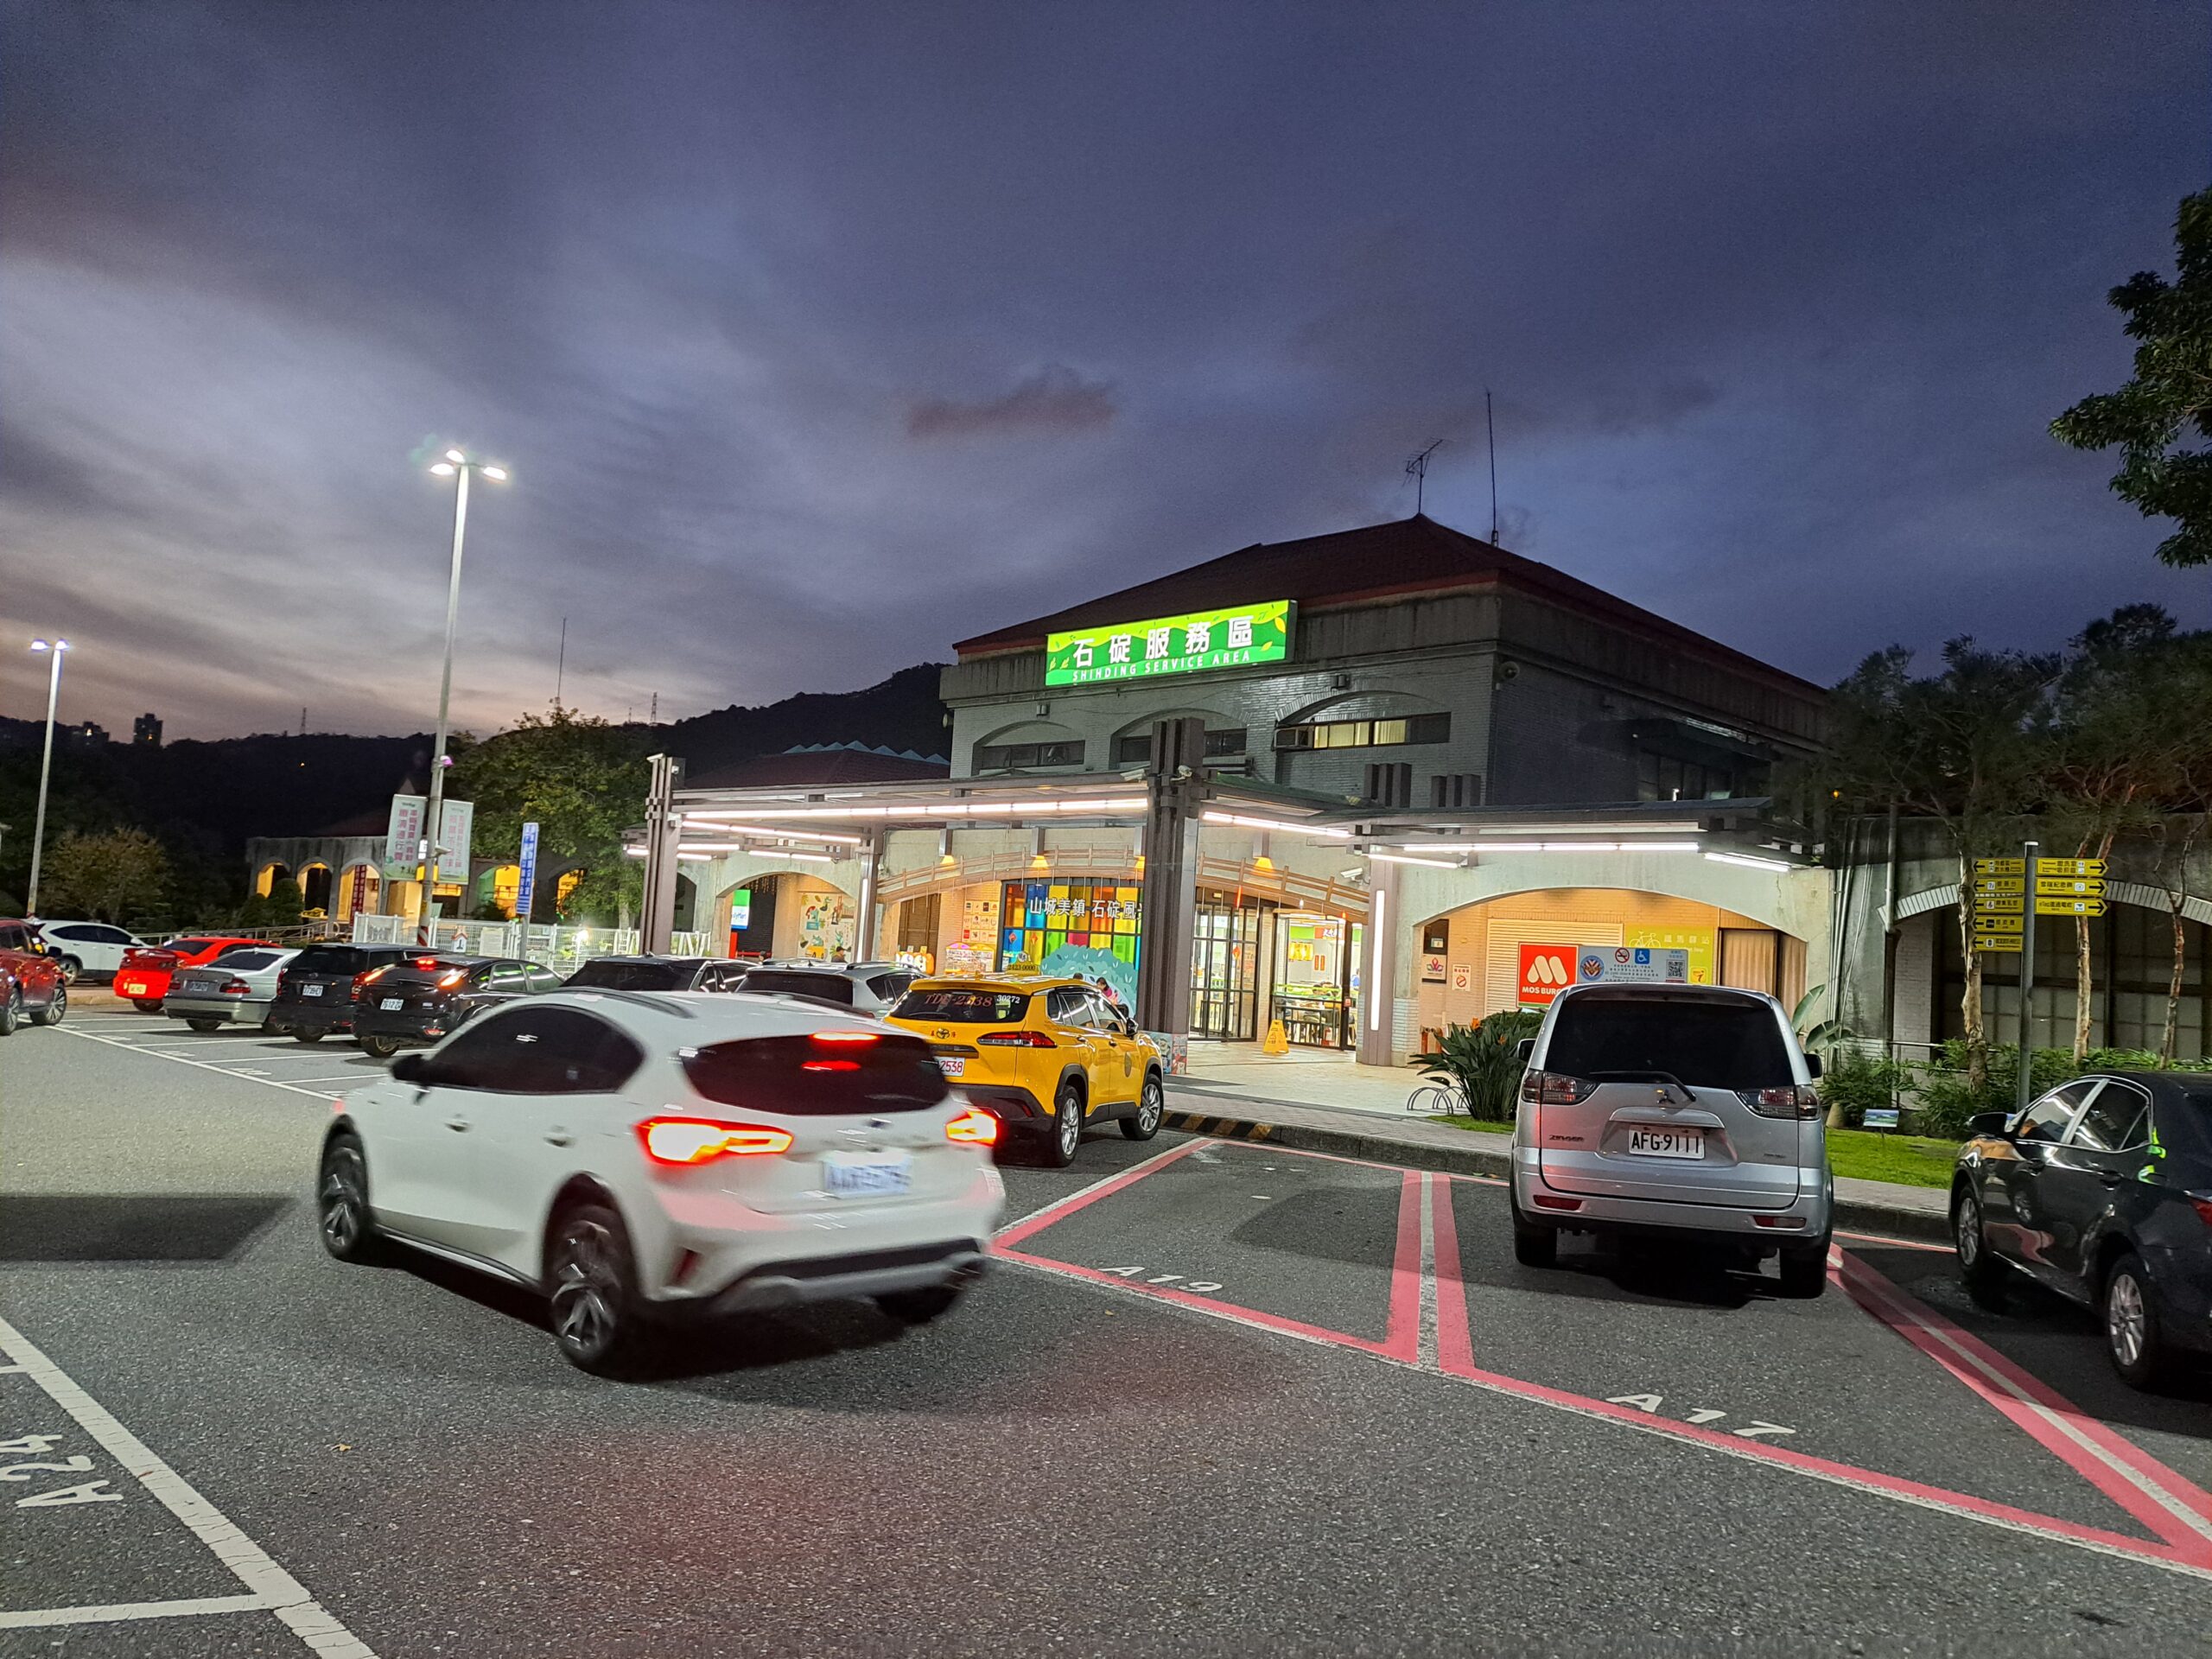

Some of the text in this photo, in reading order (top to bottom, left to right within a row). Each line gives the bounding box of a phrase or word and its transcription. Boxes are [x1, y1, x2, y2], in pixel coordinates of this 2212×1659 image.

[1073, 614, 1255, 668] 石碇服務區
[1072, 650, 1250, 682] SHIHDING SERVICE AREA
[1029, 896, 1085, 917] 山城美鎮
[996, 994, 1020, 1004] 30272
[938, 1060, 963, 1073] 2538
[1630, 1130, 1700, 1154] AFG-9111
[1097, 1266, 1224, 1293] A19
[1605, 1393, 1797, 1438] A17
[0, 1433, 124, 1509] A24
